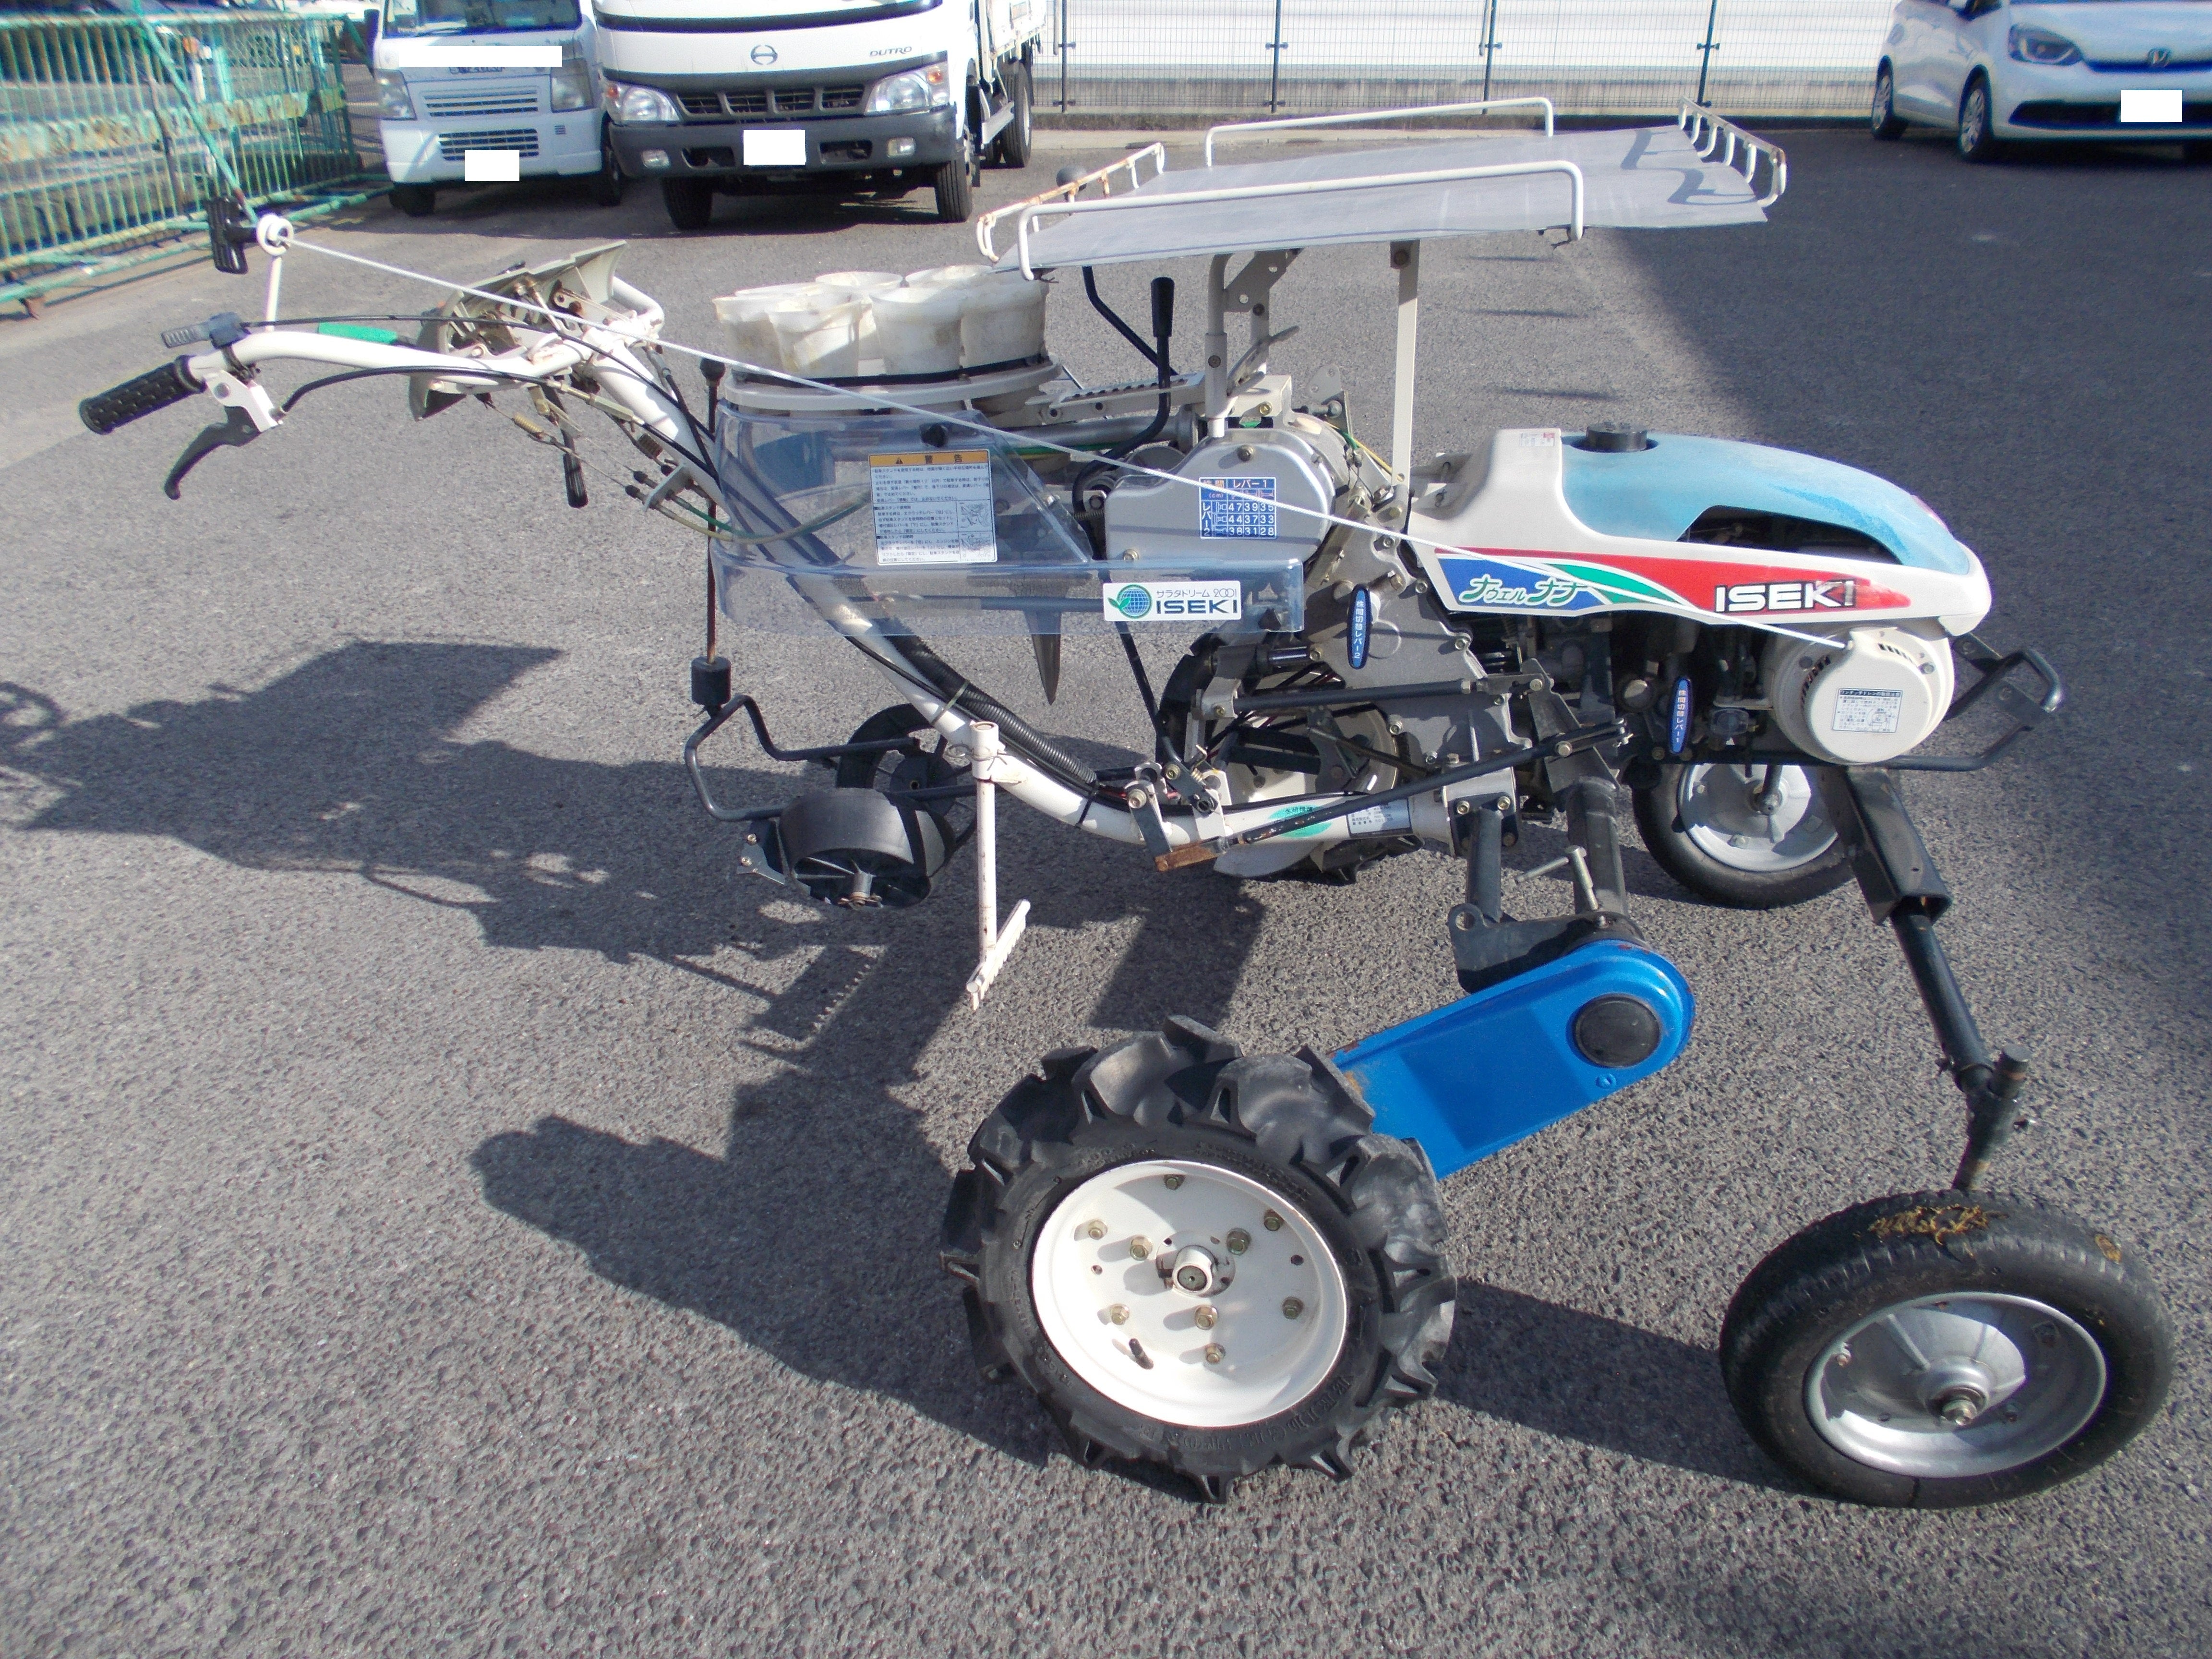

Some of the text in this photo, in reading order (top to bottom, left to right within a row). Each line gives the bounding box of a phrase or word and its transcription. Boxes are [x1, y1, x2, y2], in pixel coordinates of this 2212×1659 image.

[869, 46, 912, 57] DUTRO
[1228, 503, 1274, 511] 47 39 35
[1228, 515, 1274, 523] 44 37 33
[1156, 589, 1237, 598] サラダドリーム 2001
[1716, 580, 1854, 612] ISEKI
[1156, 600, 1238, 614] ISEKI
